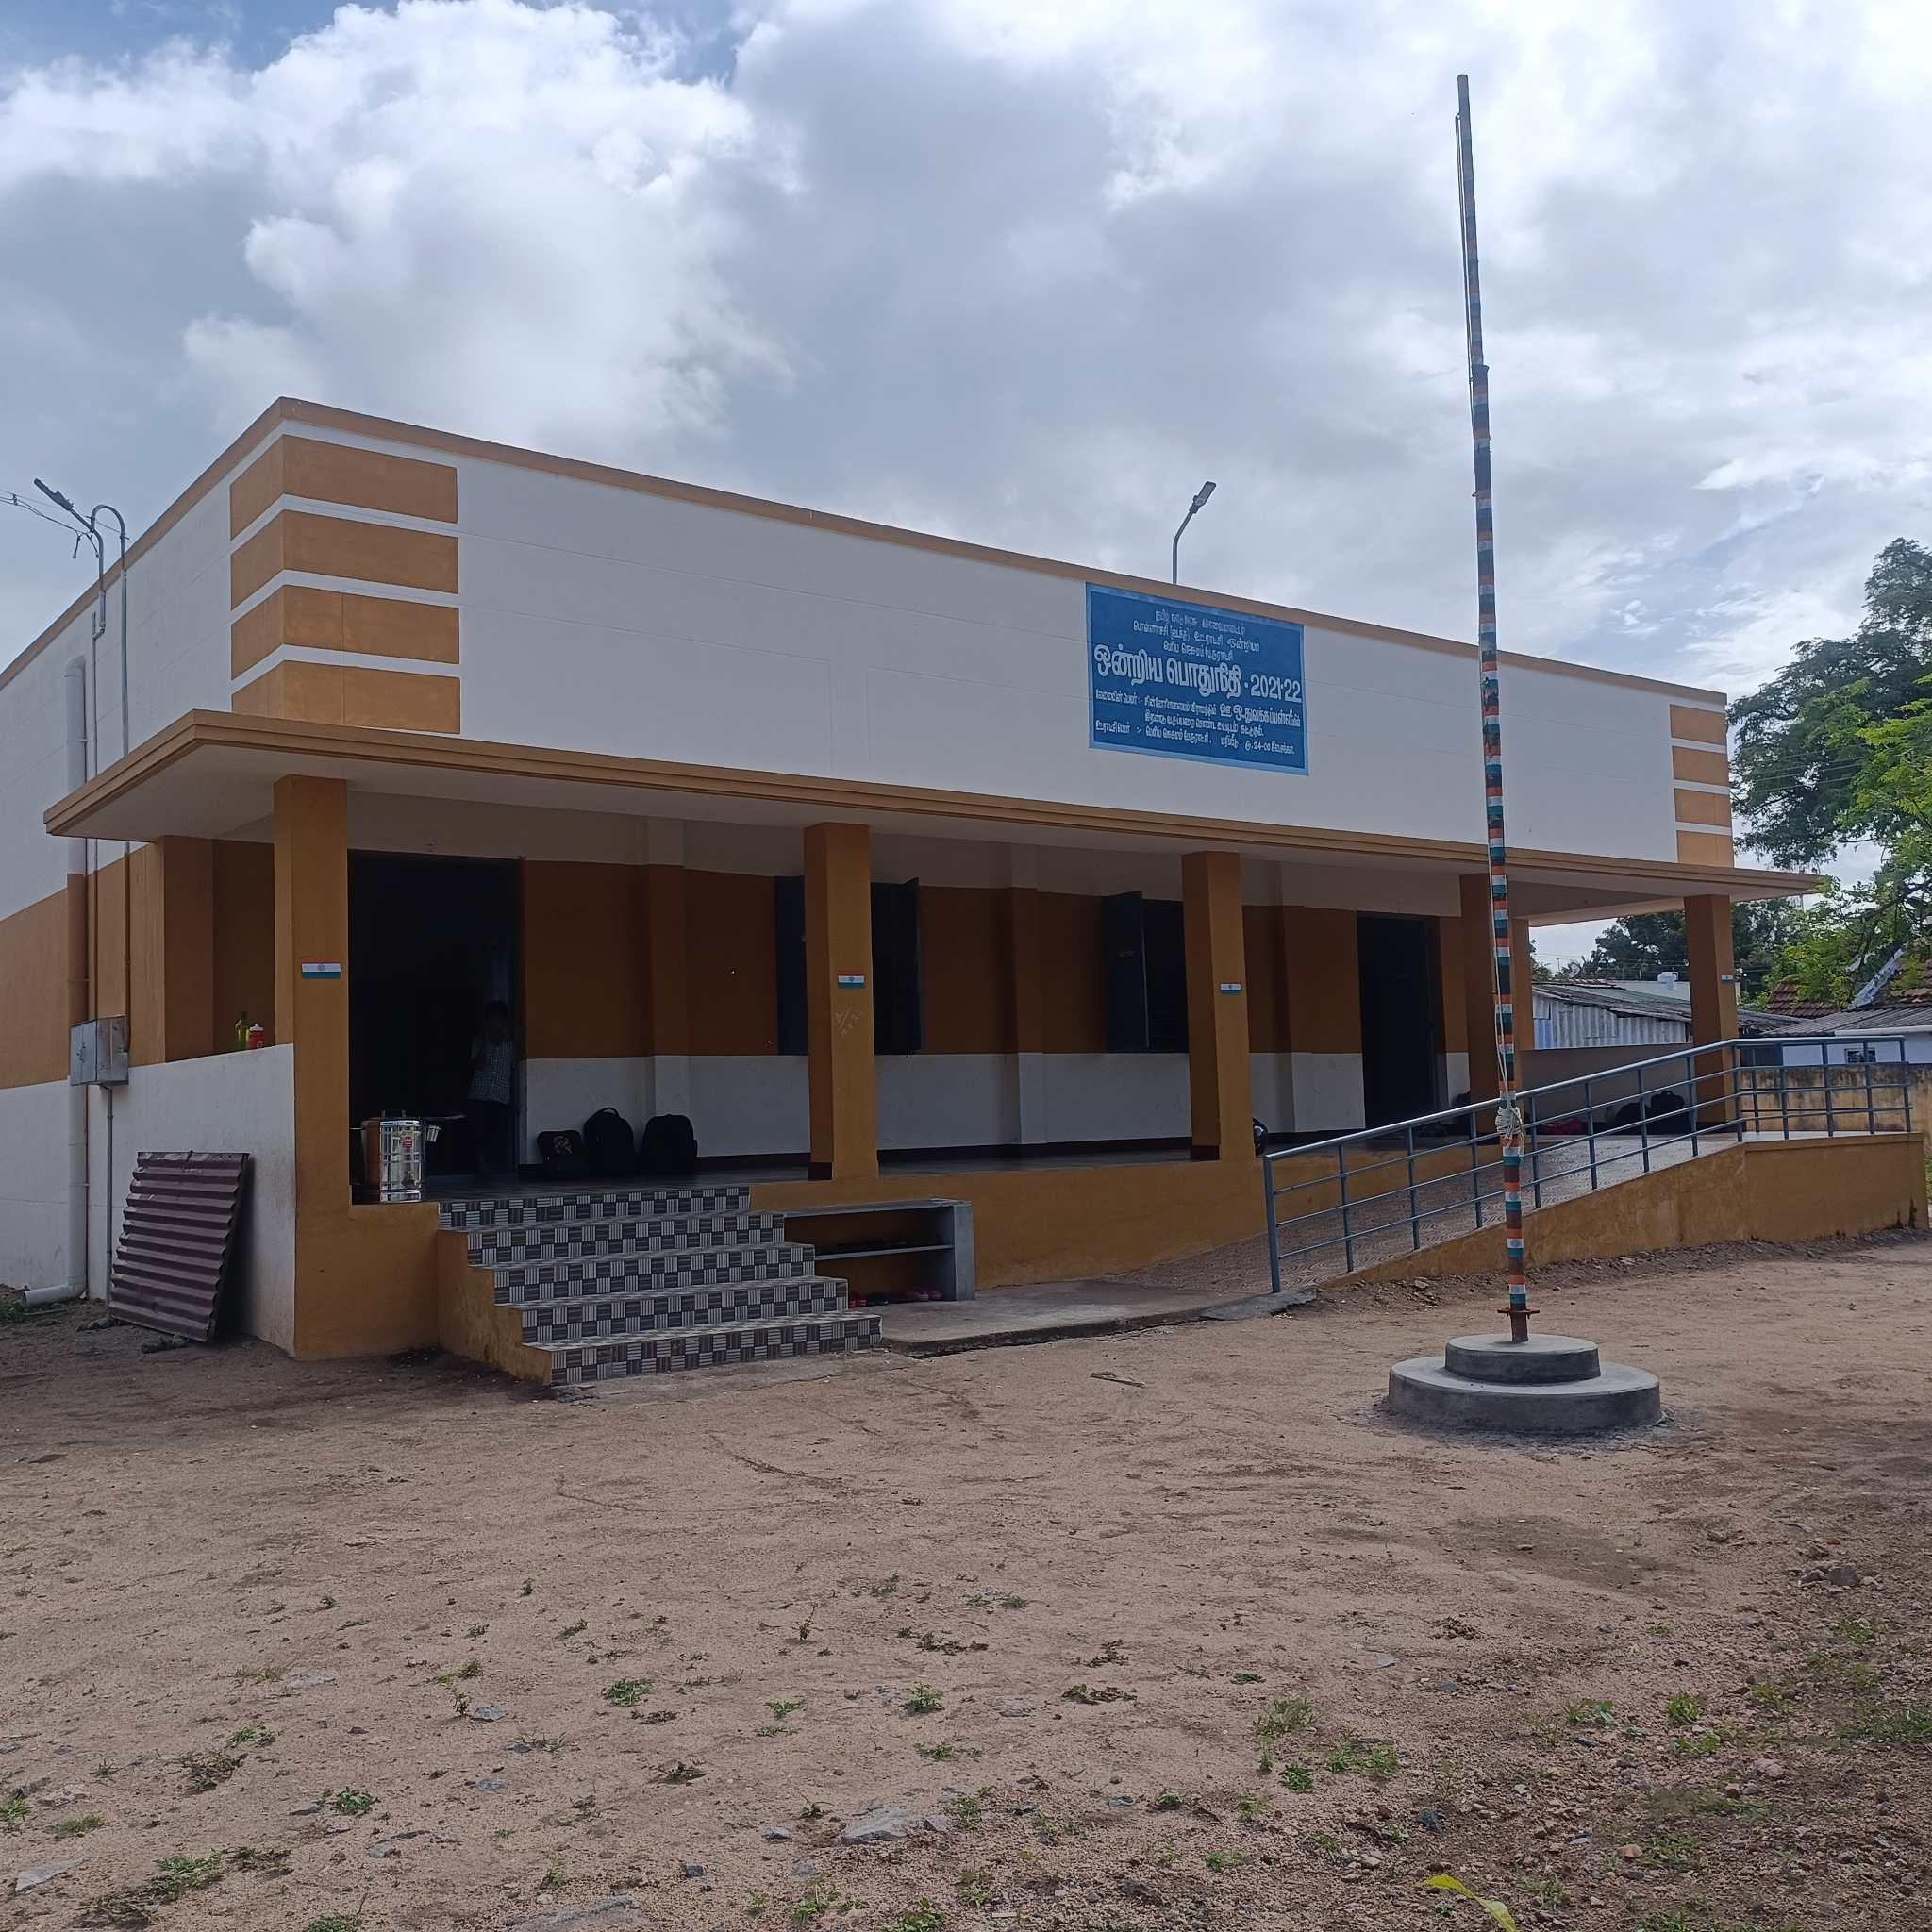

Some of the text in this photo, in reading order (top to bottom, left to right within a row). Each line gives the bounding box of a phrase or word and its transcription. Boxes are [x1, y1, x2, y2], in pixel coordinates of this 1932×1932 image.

[1134, 620, 1168, 636] பொள்ளாச்சி
[1194, 631, 1223, 645] ஊராட்சி
[1227, 638, 1259, 653] ஒன்றியம்
[1094, 643, 1163, 686] ஒன்றிய
[1167, 658, 1241, 699] பொதுநிதி
